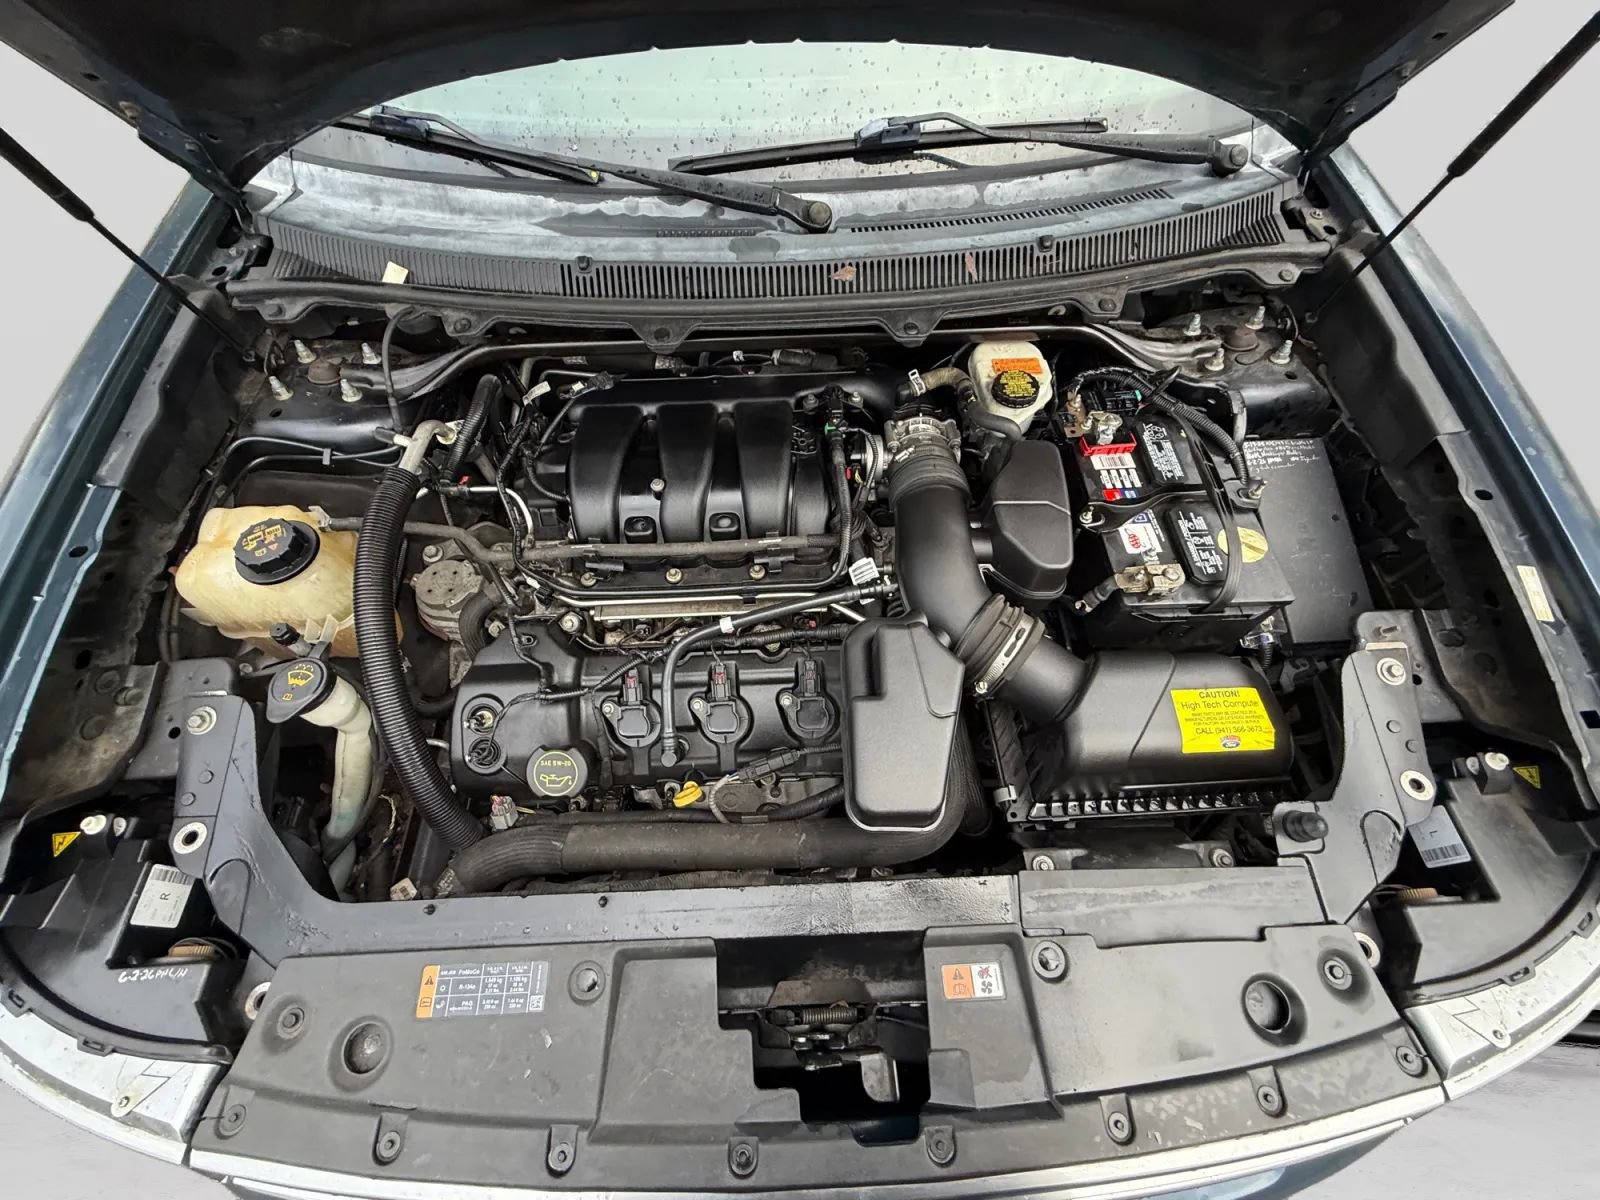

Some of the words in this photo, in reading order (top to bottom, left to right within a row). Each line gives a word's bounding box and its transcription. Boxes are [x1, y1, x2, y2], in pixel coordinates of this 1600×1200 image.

[1198, 690, 1241, 699] CAUTION!
[1180, 702, 1201, 711] High
[1203, 700, 1222, 709] Tech
[1195, 727, 1215, 735] CALL
[159, 892, 172, 901] R
